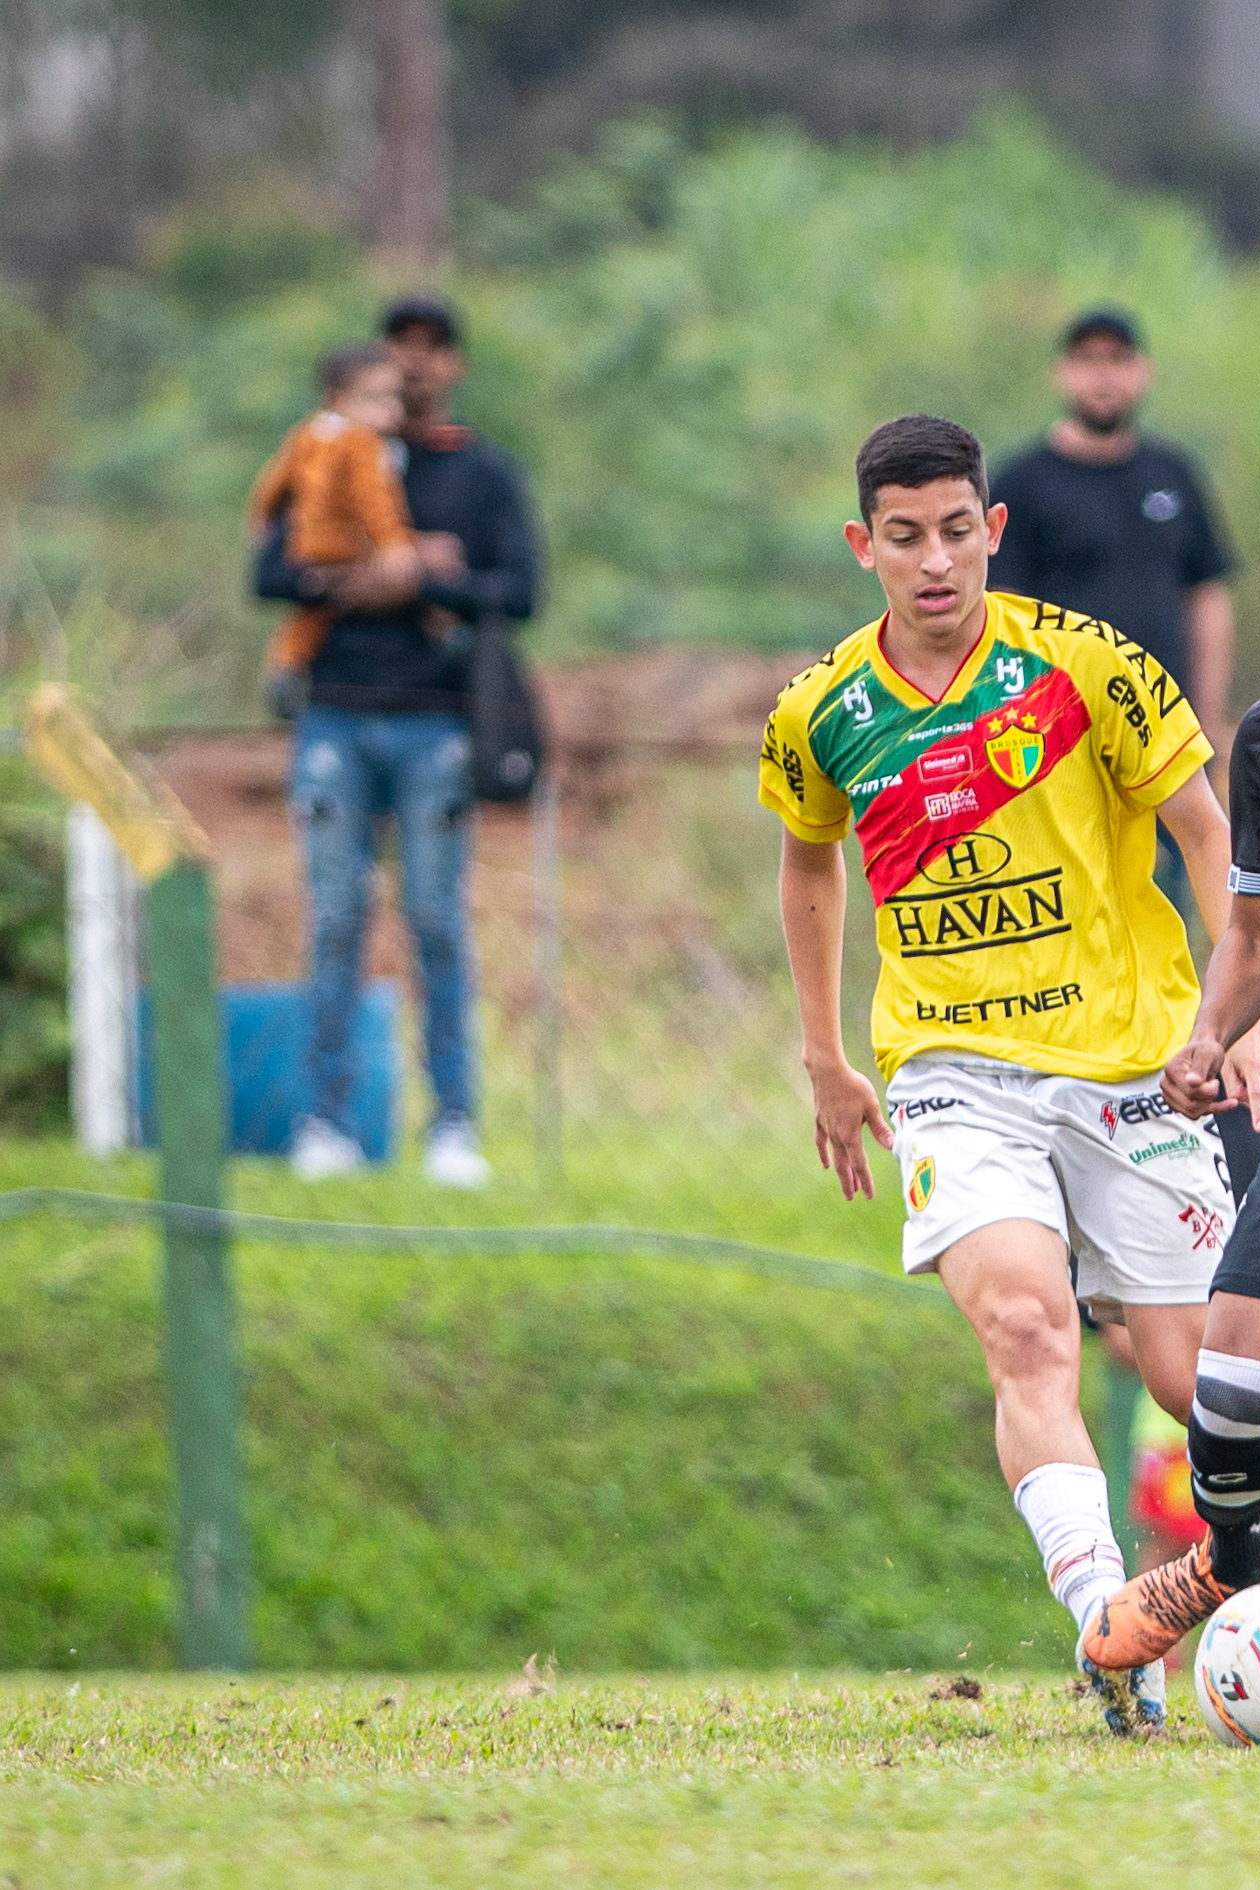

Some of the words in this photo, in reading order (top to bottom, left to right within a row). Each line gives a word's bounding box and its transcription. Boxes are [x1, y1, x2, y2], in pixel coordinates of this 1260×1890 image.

[1029, 601, 1186, 719] HAVAN
[1107, 674, 1153, 748] ERBS
[943, 839, 984, 879] H
[890, 880, 1065, 946] HAVAN
[1128, 1132, 1188, 1164] Unimed
